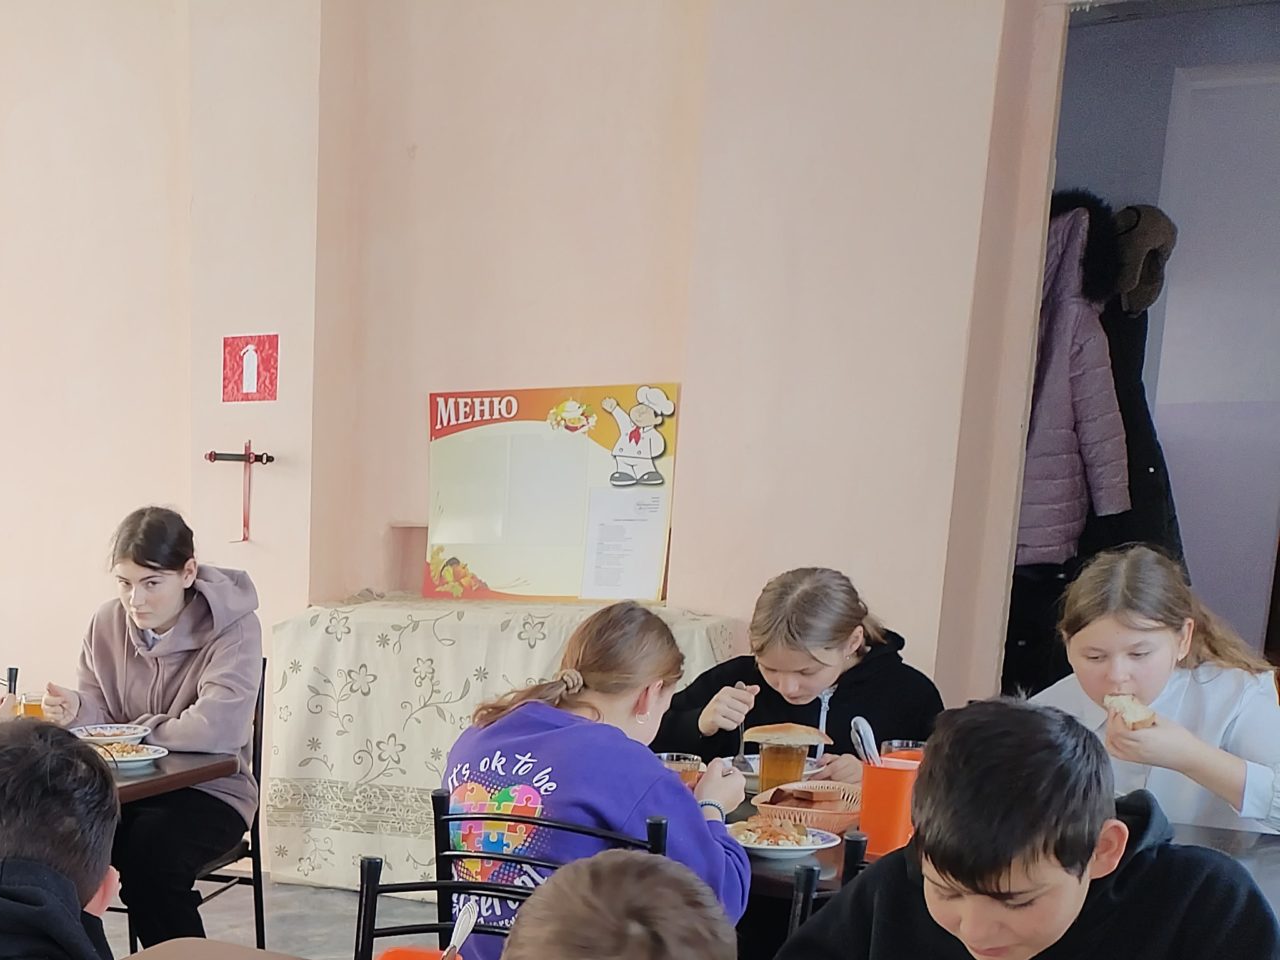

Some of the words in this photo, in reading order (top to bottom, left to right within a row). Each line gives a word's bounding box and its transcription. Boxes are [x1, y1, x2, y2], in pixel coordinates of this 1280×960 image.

[434, 395, 519, 430] МЕНЮ
[479, 750, 507, 776] ok
[512, 752, 538, 776] to
[532, 767, 558, 796] be
